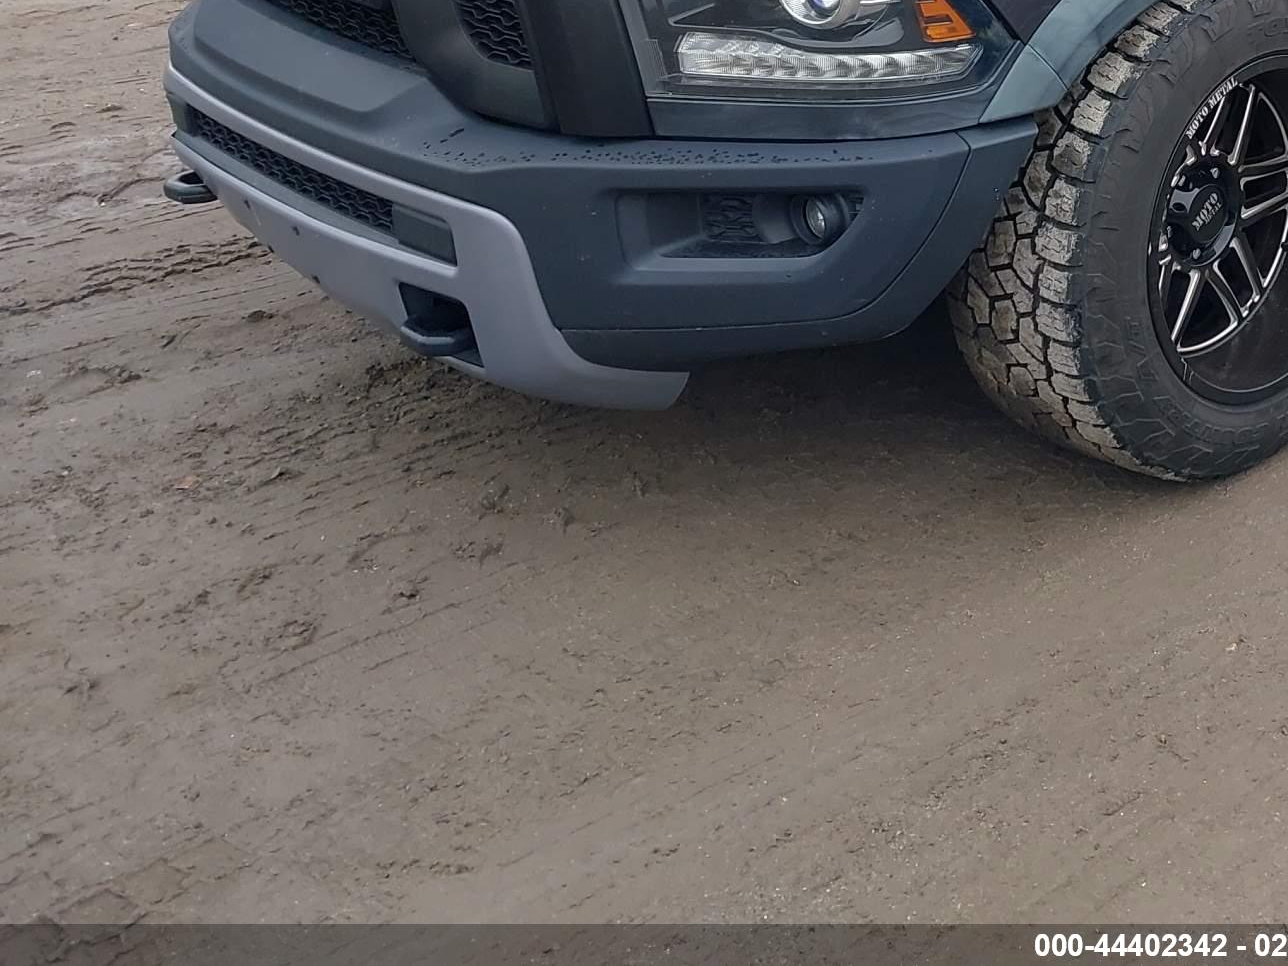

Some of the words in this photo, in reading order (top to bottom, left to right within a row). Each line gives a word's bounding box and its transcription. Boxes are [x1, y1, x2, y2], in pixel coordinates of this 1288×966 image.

[1186, 106, 1209, 139] MOTO
[1208, 75, 1238, 109] METAL
[1191, 192, 1218, 231] MOTO
